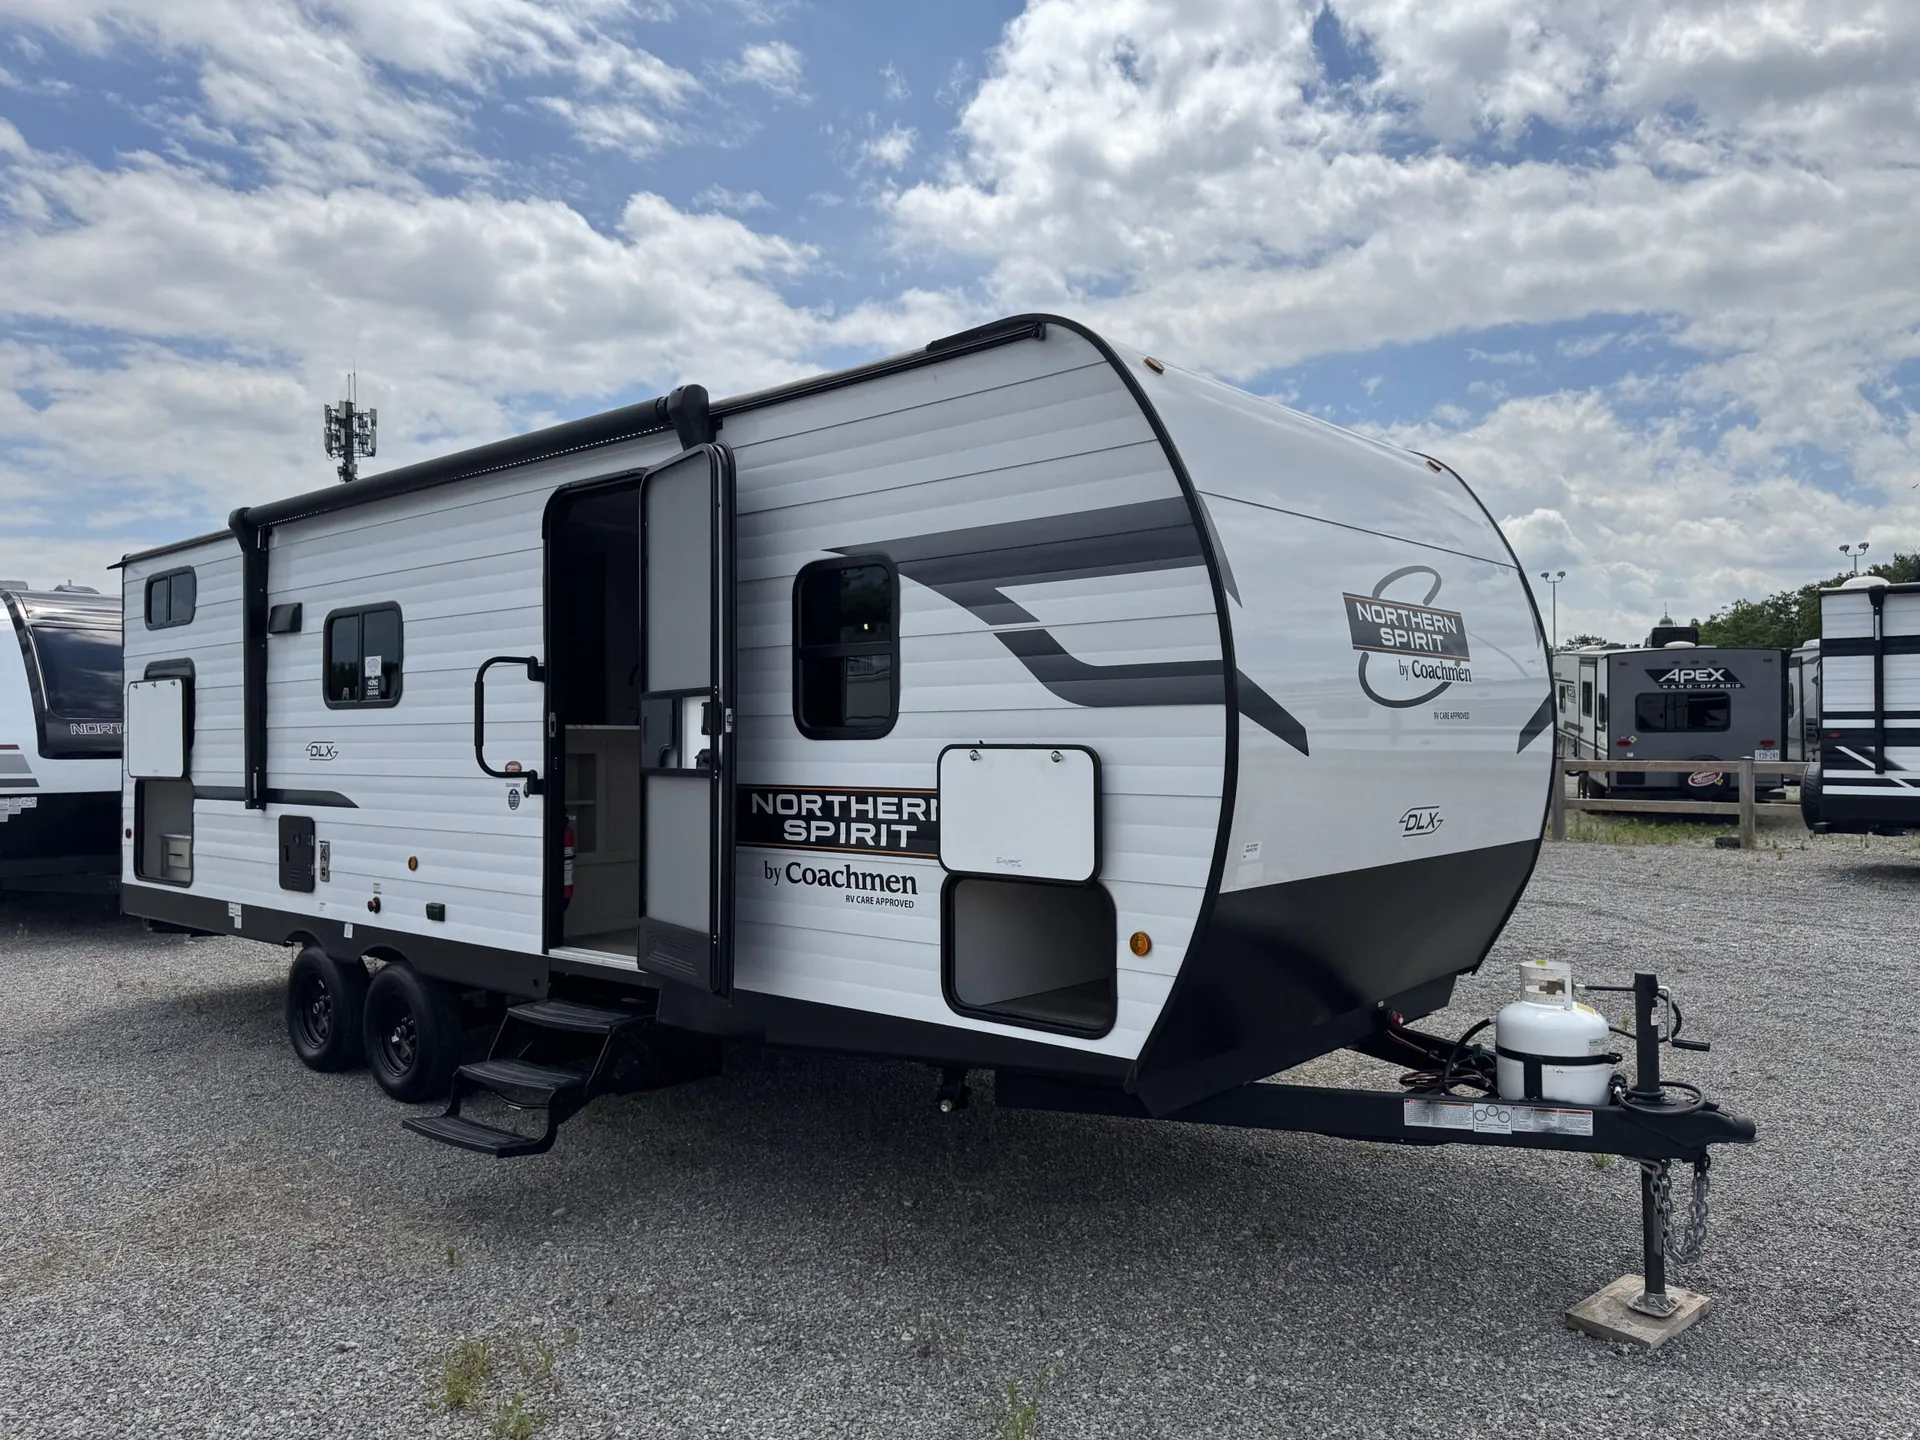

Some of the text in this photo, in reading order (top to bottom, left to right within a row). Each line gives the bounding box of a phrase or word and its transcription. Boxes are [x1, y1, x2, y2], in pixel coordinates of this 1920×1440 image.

[1355, 602, 1458, 635] NORTHERN
[1379, 627, 1444, 652] SPIRIT
[1398, 659, 1473, 682] by Coachmen
[1658, 667, 1726, 684] APEX
[1439, 711, 1450, 720] CARE
[1450, 711, 1470, 720] APPROVED
[310, 745, 334, 757] DLX
[1404, 811, 1440, 831] DLX
[783, 819, 917, 848] SPIRIT
[763, 861, 918, 895] by Coachmen
[845, 894, 915, 909] RV CARE APPROVED
